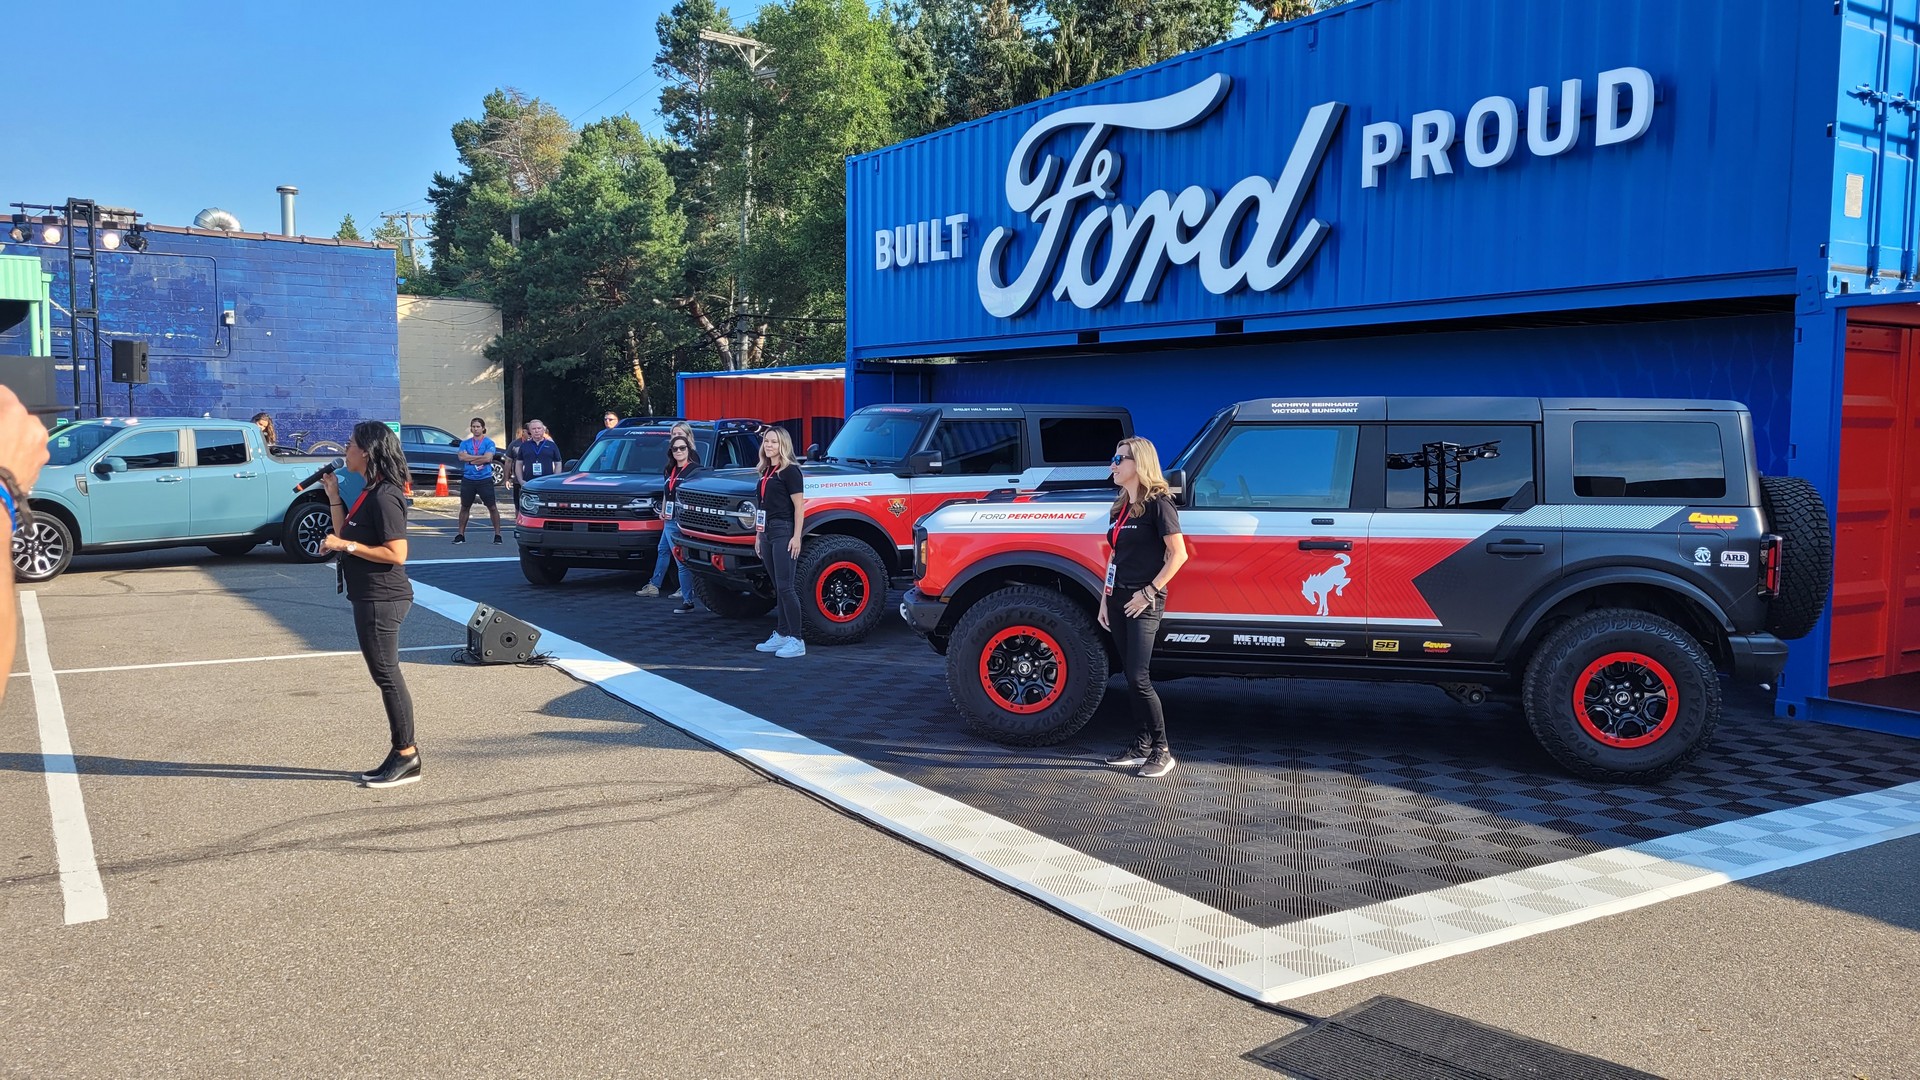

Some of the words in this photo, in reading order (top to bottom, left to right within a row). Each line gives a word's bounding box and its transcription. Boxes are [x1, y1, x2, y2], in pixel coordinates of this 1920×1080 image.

[876, 213, 968, 270] BUILT
[977, 72, 1347, 318] Ford
[1361, 67, 1655, 189] PROUD
[1007, 512, 1087, 520] PERFORMANCE
[1725, 554, 1746, 562] ARB
[1164, 633, 1211, 643] RIGID
[1233, 634, 1285, 644] METHOD
[1374, 641, 1397, 649] SB
